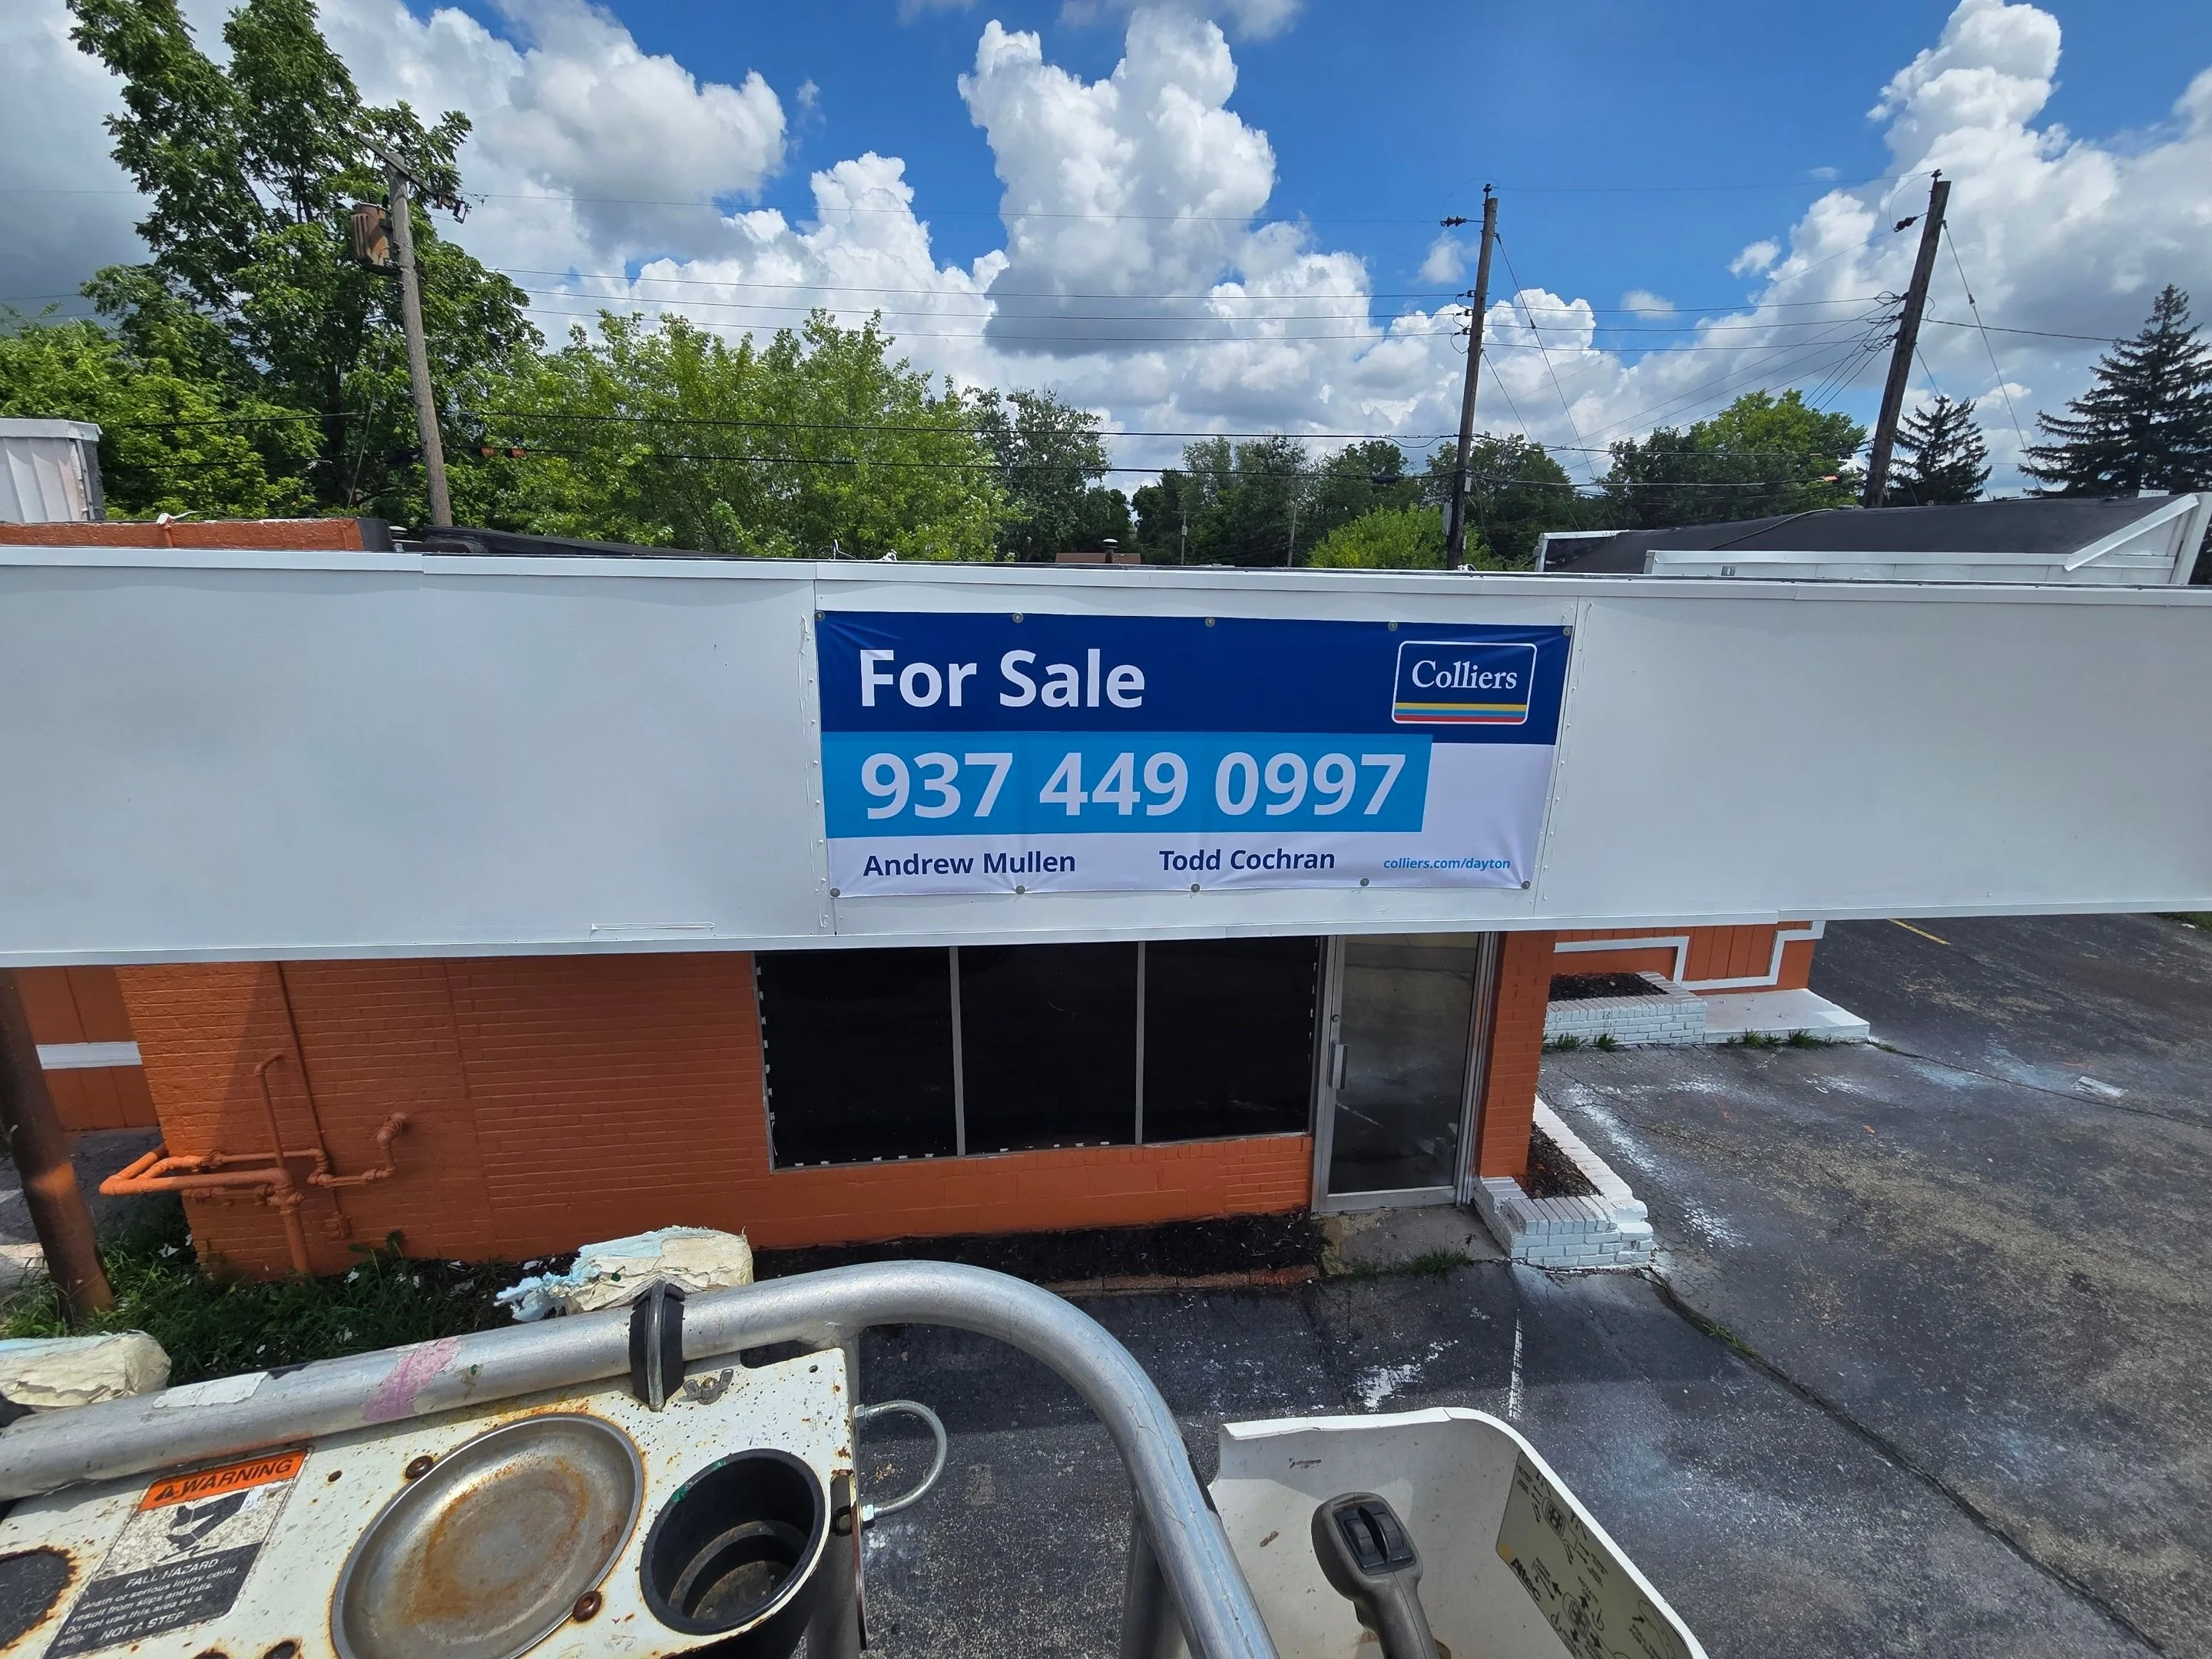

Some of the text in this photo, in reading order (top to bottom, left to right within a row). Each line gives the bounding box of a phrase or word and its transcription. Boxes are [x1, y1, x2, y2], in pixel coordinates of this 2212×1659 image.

[859, 648, 1145, 708] For Sale
[1412, 660, 1518, 690] Colliers
[861, 752, 1406, 820] 937 449 0997
[863, 850, 1075, 876] Andrew Mullen
[1159, 848, 1335, 871] Todd Cochran
[1383, 856, 1511, 872] colliers.com/dayton
[179, 1459, 294, 1497] WARNING
[115, 1594, 129, 1602] or
[130, 1584, 171, 1599] serious
[172, 1575, 204, 1588] injury
[207, 1566, 237, 1580] could
[124, 1558, 219, 1589] FALL HAZARD
[1510, 1557, 1541, 1601] Altec
[65, 1626, 81, 1635] Do
[84, 1619, 104, 1630] not
[106, 1614, 127, 1624] use
[129, 1608, 151, 1619] this
[153, 1601, 177, 1612] area
[179, 1598, 193, 1606] as
[72, 1608, 106, 1623] result
[107, 1601, 134, 1614] from
[136, 1595, 164, 1607] slips
[165, 1588, 187, 1601] and
[100, 1624, 134, 1641] NOT
[132, 1621, 144, 1632] A
[147, 1611, 186, 1628] STEP
